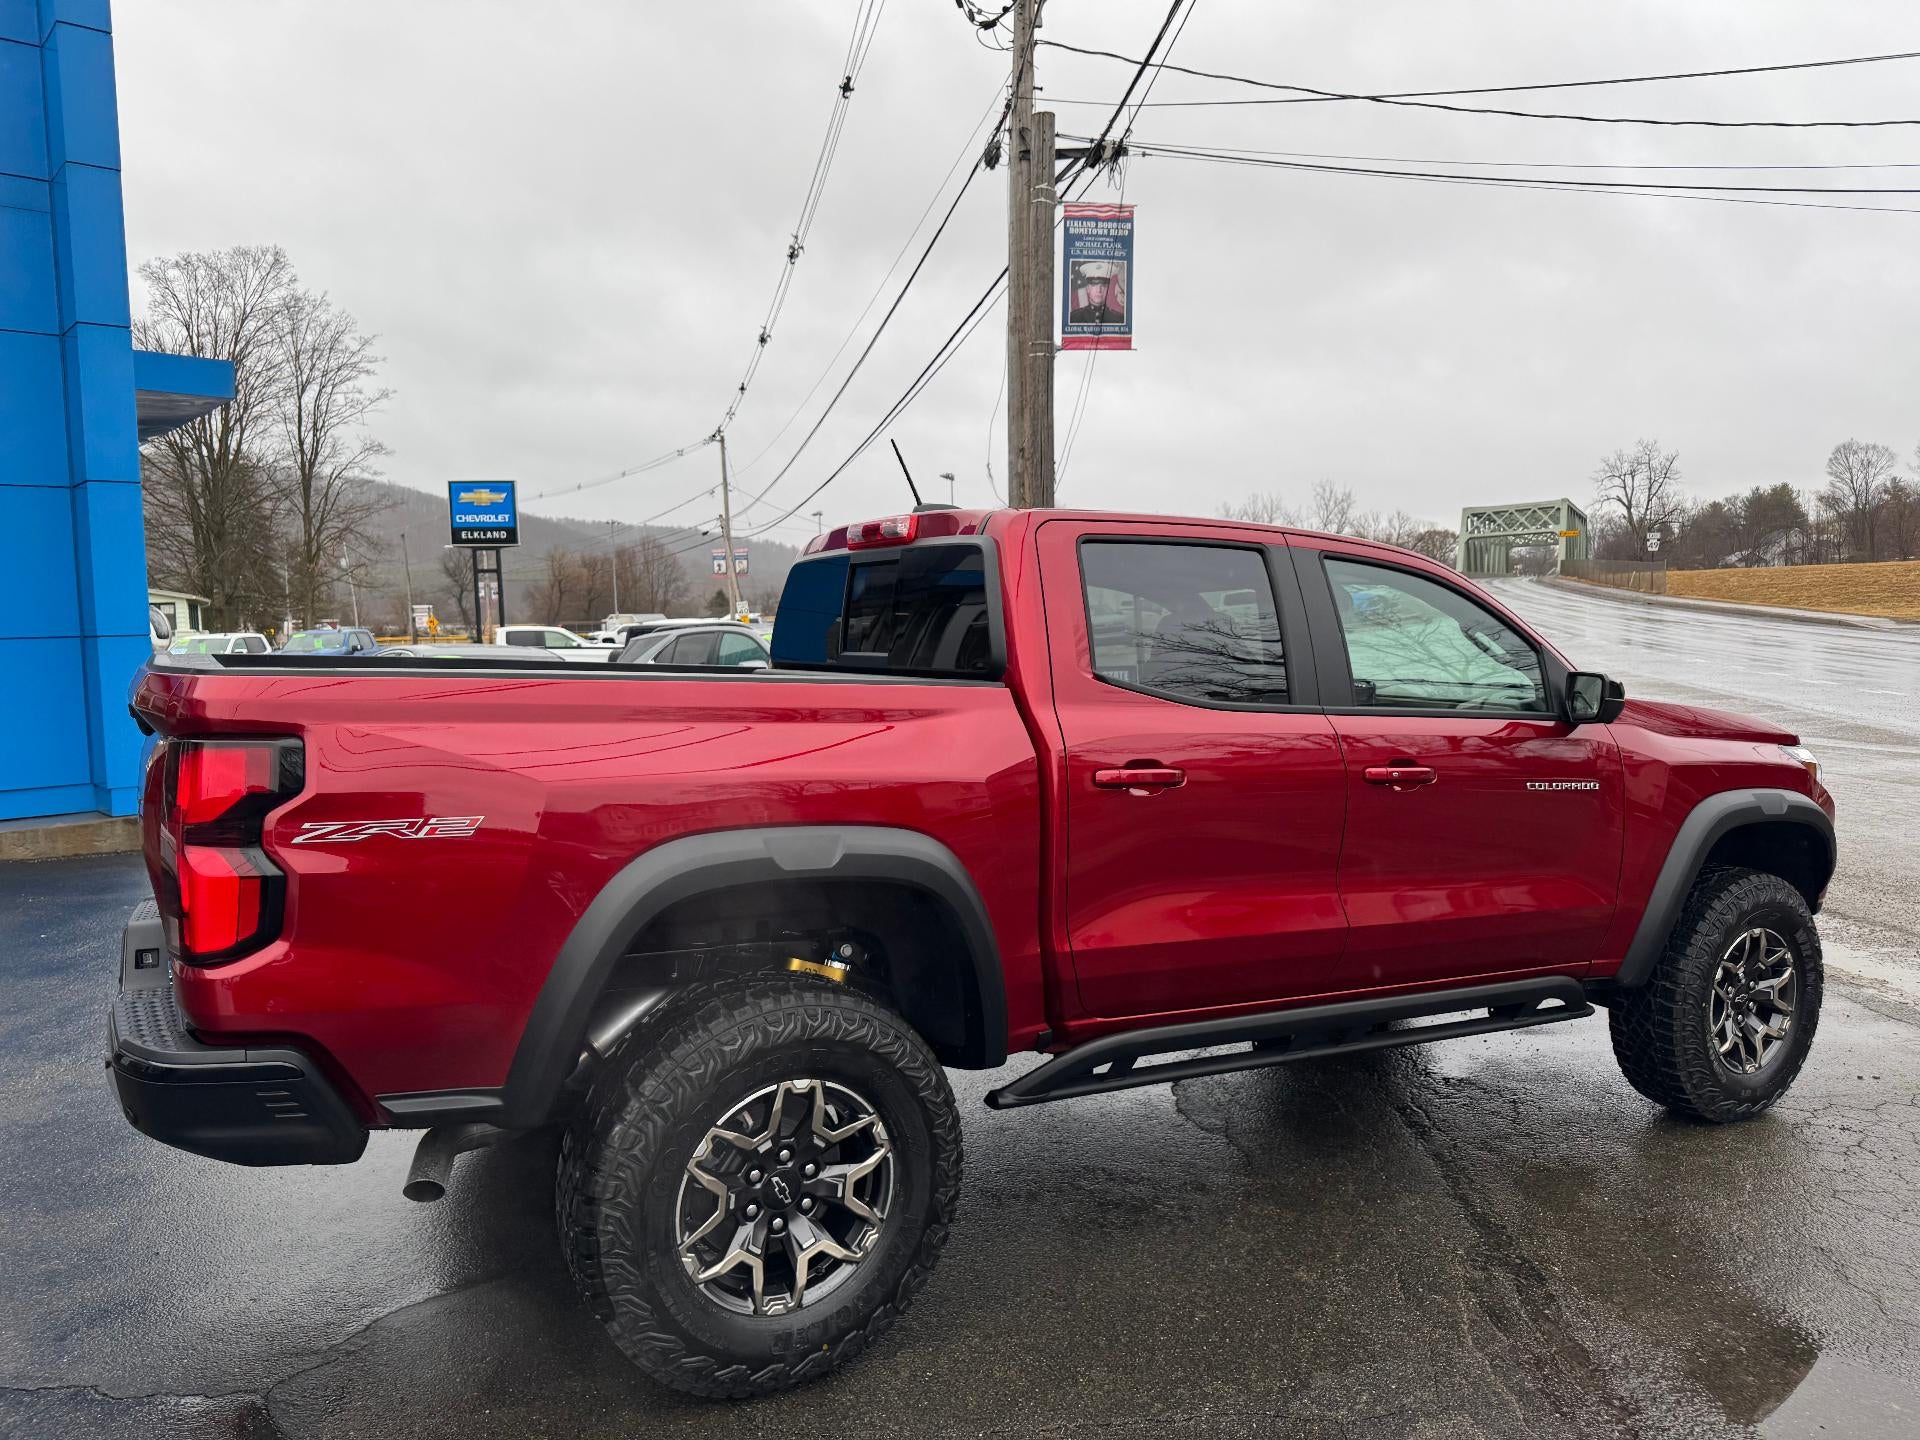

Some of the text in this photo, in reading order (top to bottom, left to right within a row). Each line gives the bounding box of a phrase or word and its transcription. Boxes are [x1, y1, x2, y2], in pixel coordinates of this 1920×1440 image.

[456, 514, 510, 523] CHEVROLET
[461, 530, 507, 539] ELKLAND
[1526, 782, 1600, 790] COLORADO
[291, 816, 485, 843] ZR2
